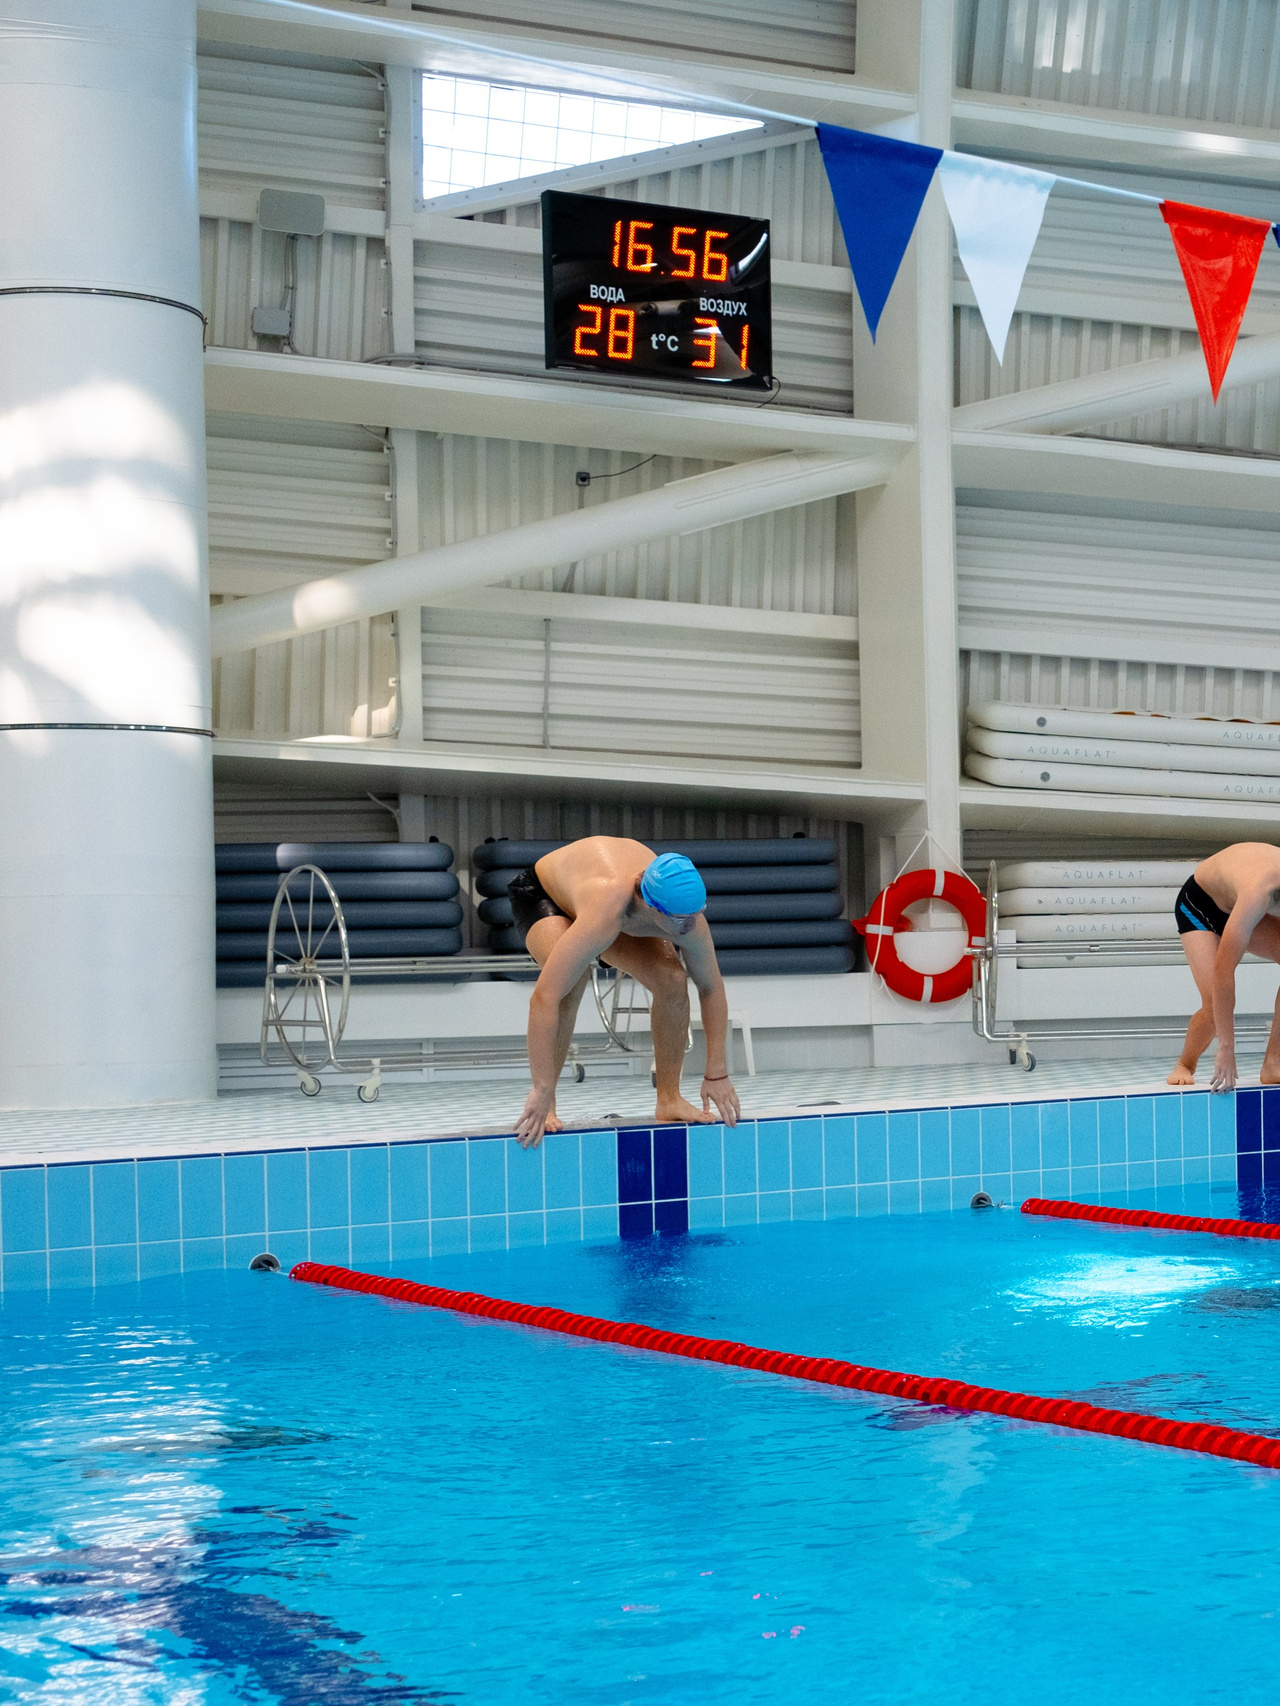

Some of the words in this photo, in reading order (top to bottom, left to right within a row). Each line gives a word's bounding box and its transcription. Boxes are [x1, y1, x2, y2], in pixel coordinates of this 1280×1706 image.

[590, 284, 626, 303] ВОДА
[700, 297, 748, 316] ВОЗДУХ
[574, 304, 635, 360] 28
[691, 317, 749, 371] 31
